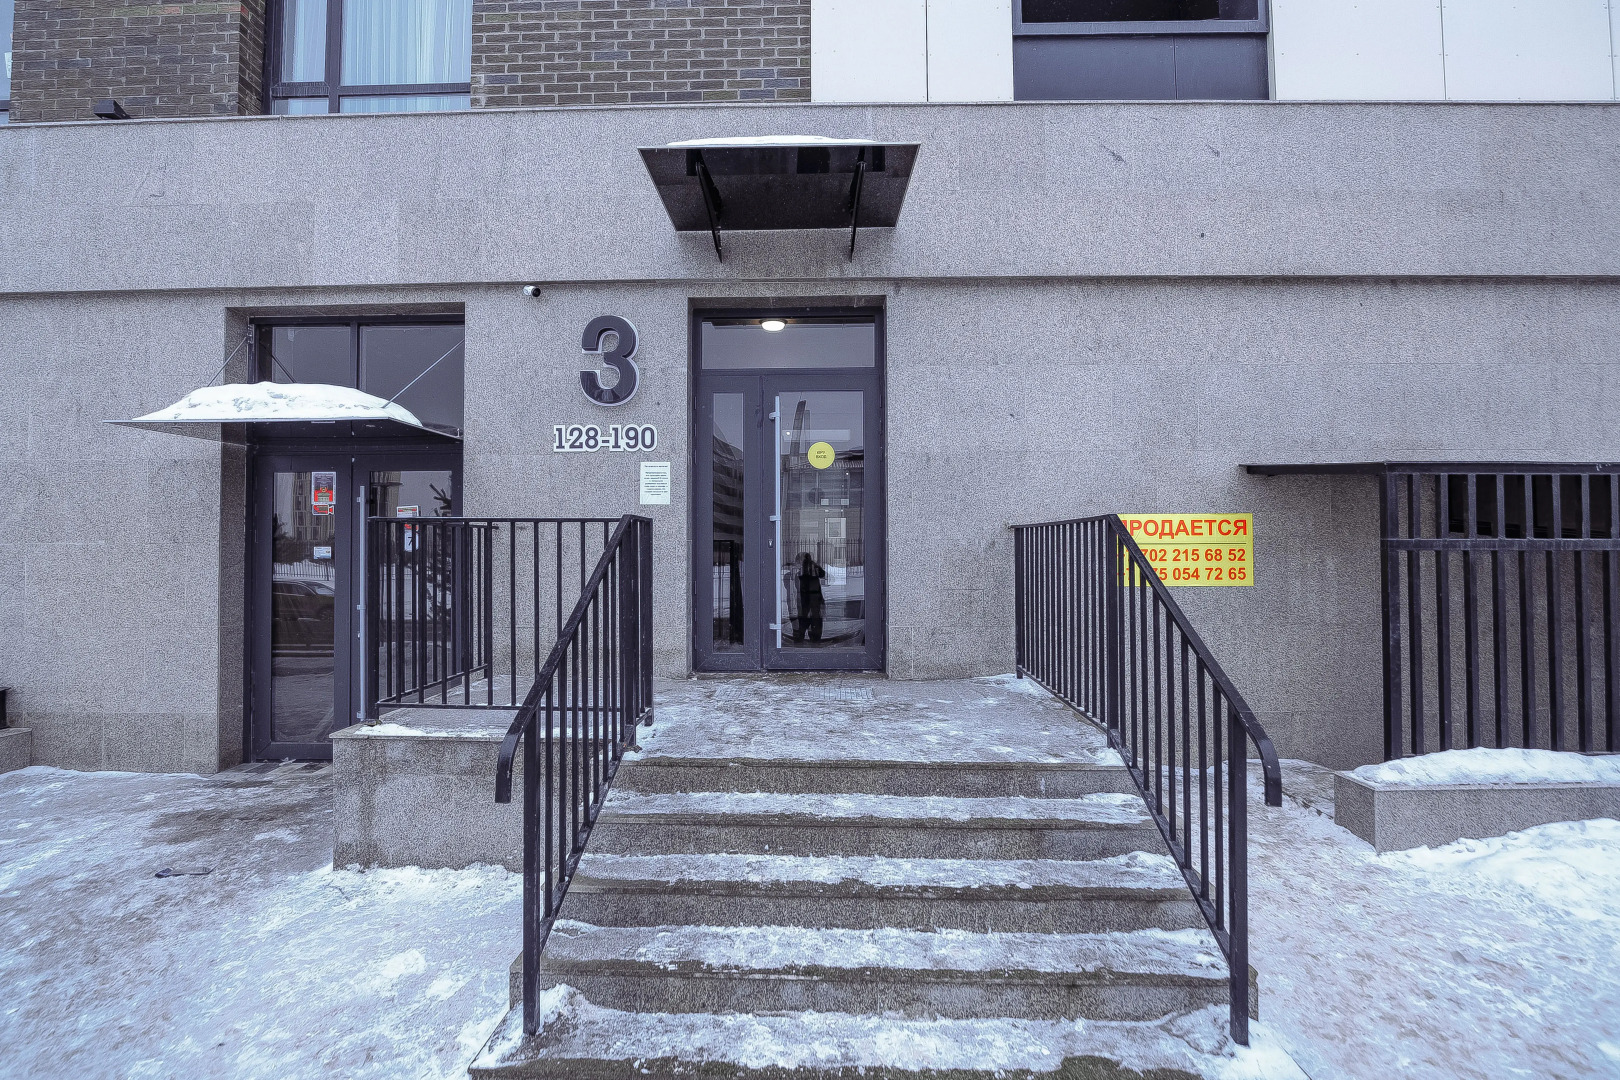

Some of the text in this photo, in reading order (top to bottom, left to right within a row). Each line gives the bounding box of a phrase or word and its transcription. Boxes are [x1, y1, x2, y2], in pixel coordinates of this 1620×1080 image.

[580, 315, 639, 406] 3
[554, 425, 657, 451] 128-190
[1172, 548, 1200, 562] 215
[1204, 548, 1223, 562] 68
[1228, 548, 1246, 562] 52
[1172, 567, 1200, 581] 054
[1205, 567, 1223, 581] 72
[1228, 567, 1247, 581] 65
